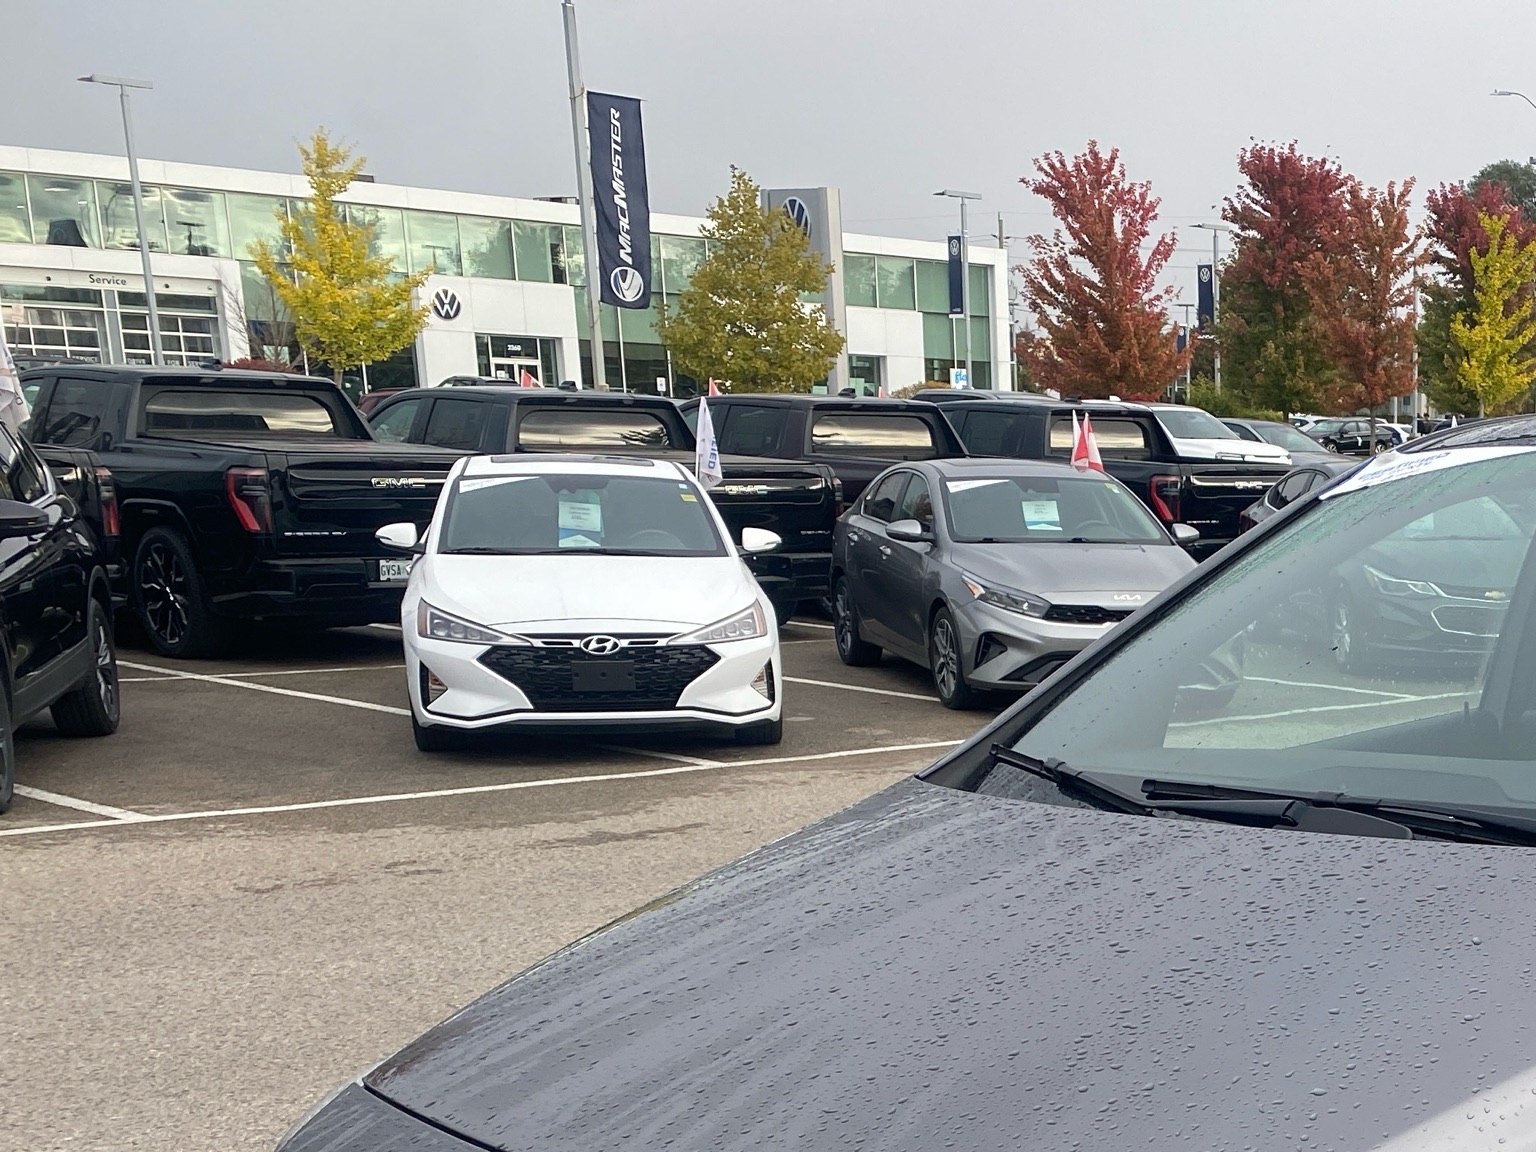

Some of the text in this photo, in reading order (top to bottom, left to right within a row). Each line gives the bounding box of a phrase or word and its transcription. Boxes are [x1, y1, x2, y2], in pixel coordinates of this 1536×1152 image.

[609, 107, 634, 266] MACMASTER
[88, 273, 128, 286] Service
[371, 477, 426, 489] GMC
